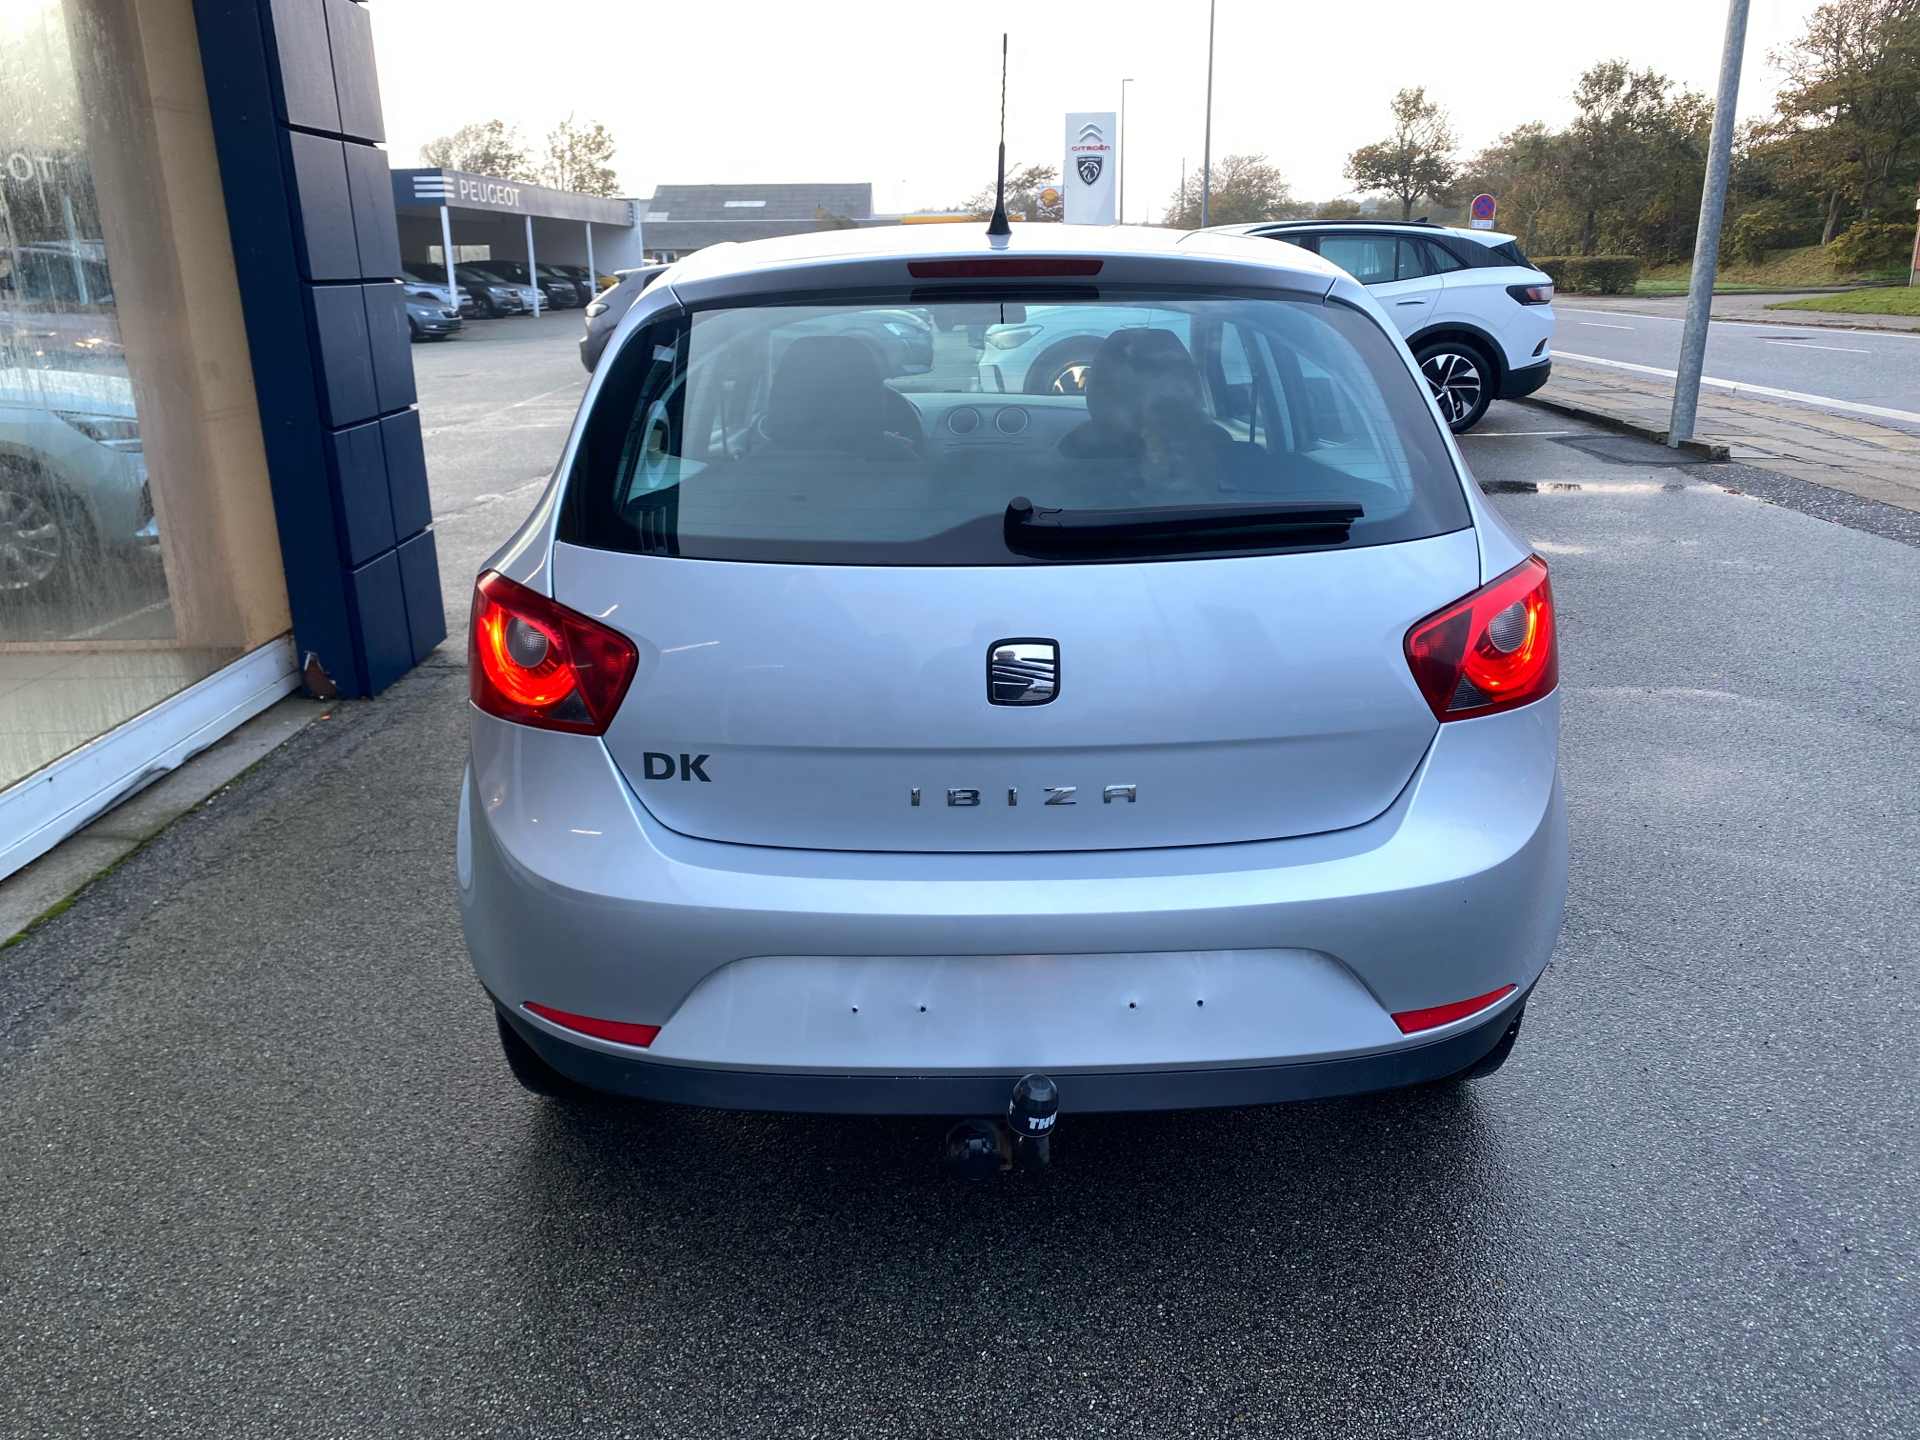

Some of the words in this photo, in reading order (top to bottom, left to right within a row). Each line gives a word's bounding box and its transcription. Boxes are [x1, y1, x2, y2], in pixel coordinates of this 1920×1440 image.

[0, 152, 53, 181] OT
[459, 179, 520, 207] PEUGEOT
[643, 751, 712, 782] DK
[911, 784, 1137, 807] IBIZA
